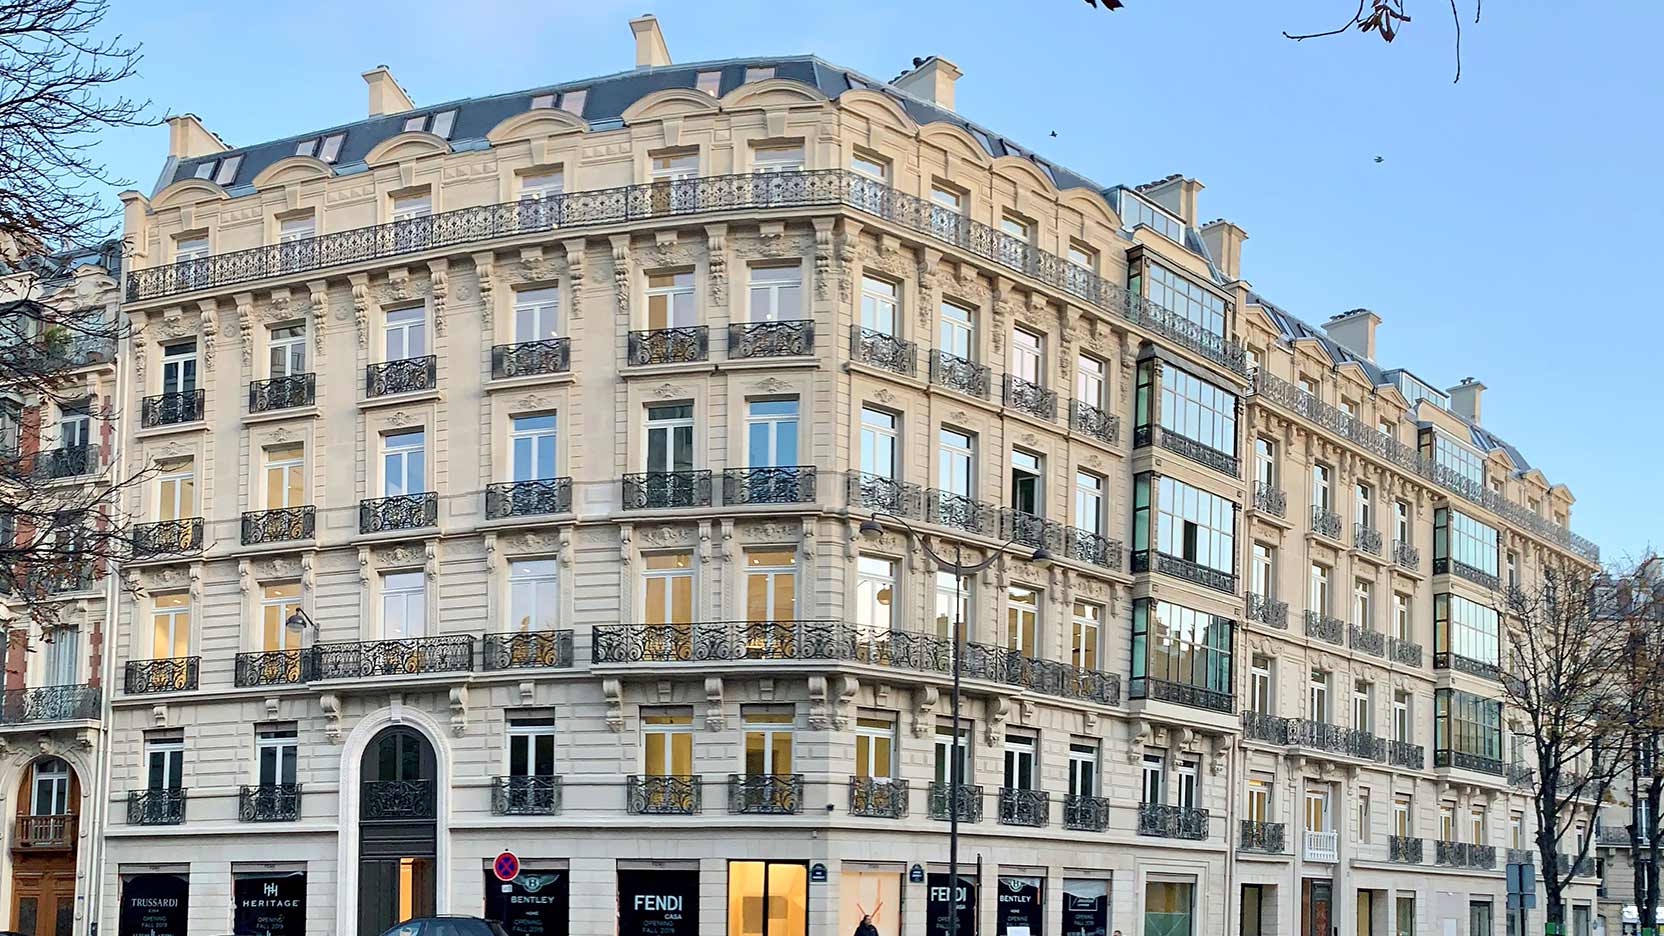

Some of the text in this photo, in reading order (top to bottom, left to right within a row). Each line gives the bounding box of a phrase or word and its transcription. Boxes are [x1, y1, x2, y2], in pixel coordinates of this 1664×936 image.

[131, 898, 178, 907] TRUSSARDI
[999, 894, 1031, 902] BENTLEY
[634, 895, 682, 911] FENDI
